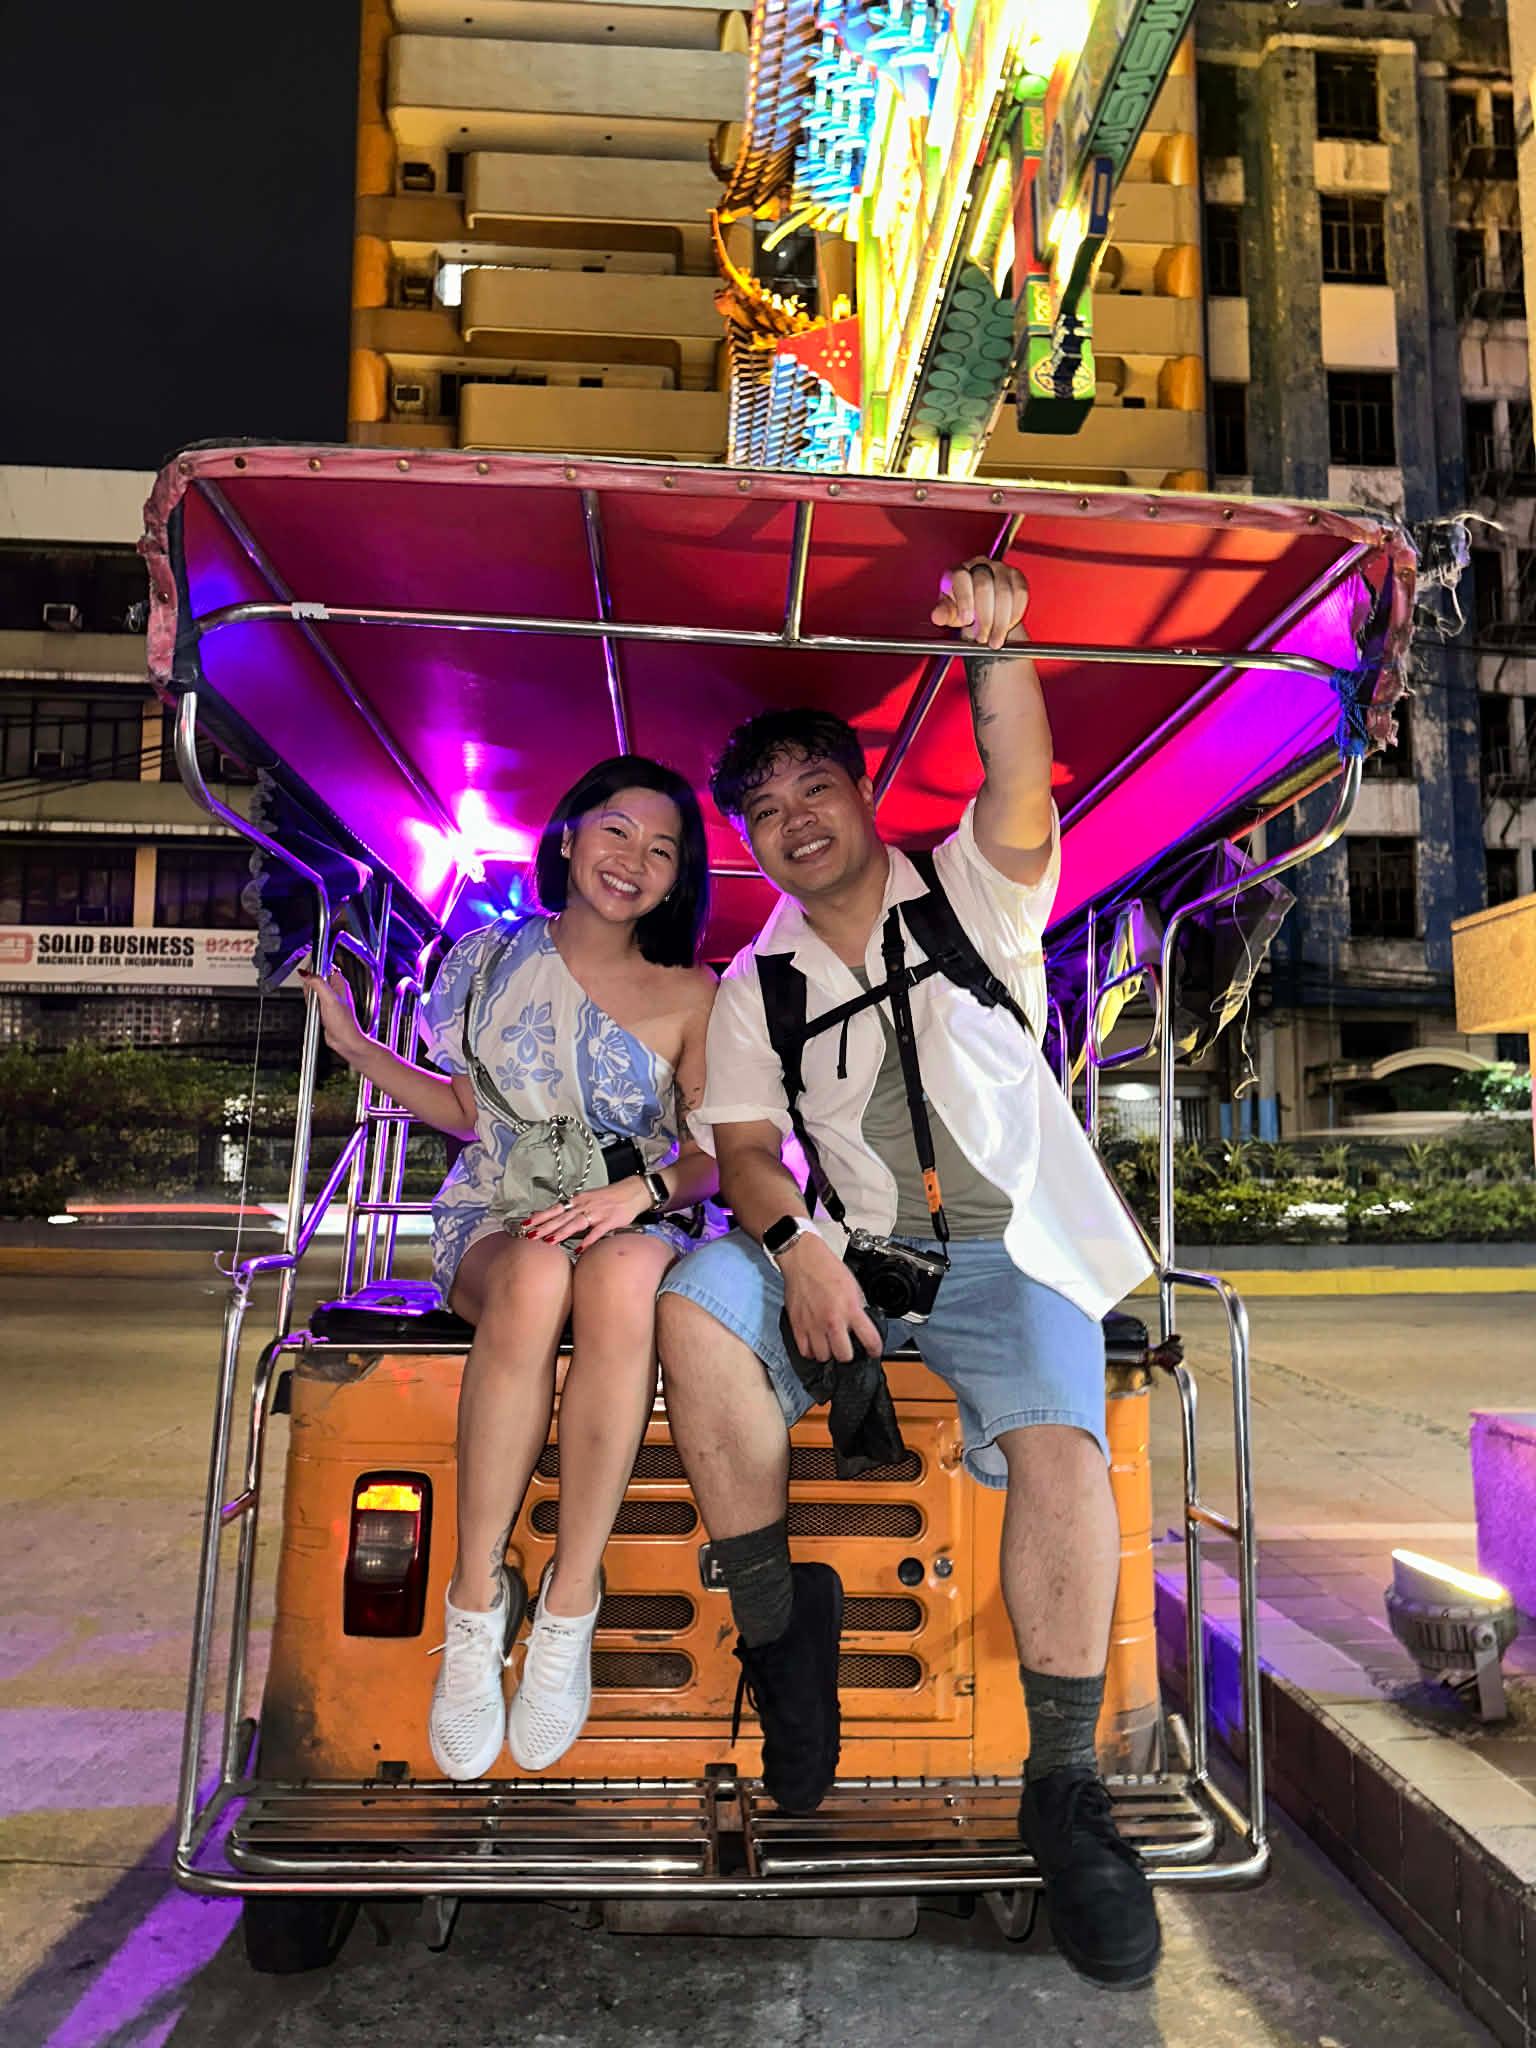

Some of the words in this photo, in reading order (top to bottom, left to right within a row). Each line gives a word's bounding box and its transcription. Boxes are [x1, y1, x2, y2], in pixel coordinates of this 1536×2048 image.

[39, 934, 94, 953] SOLID
[100, 935, 194, 956] BUSINESS
[37, 955, 84, 965] MACHINES
[87, 956, 121, 966] CENTER
[125, 957, 193, 967] INCORPORATED
[168, 986, 213, 995] CENTER
